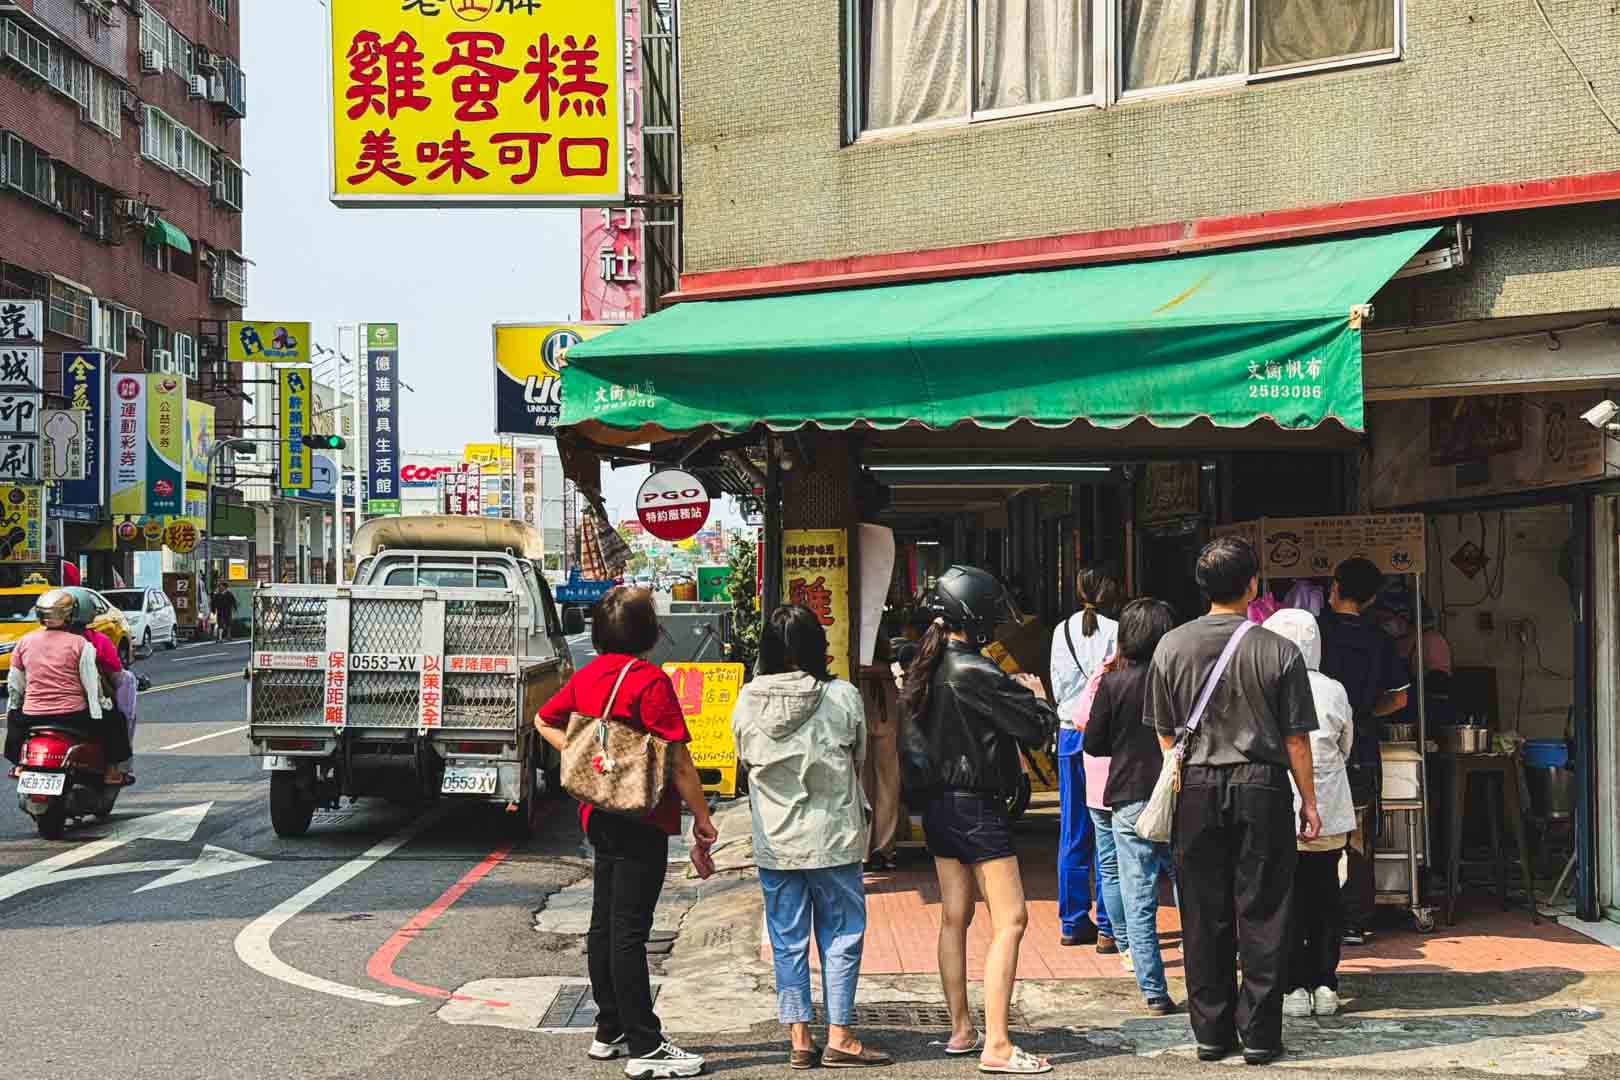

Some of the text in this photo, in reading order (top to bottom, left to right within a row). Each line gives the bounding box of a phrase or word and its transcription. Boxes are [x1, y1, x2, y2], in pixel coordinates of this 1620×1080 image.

[345, 30, 609, 122] 雞蛋糕
[346, 128, 610, 186] 美味可口
[527, 405, 558, 414] UNIQUE
[1249, 384, 1322, 399] 2583086
[120, 402, 137, 466] 運動彩券
[160, 400, 170, 448] 公益彩券
[375, 356, 392, 494] 億進寢具生活館
[643, 488, 700, 503] PGO
[645, 507, 702, 523] 特約服務站
[325, 652, 345, 724] 保持距離
[352, 655, 417, 670] 0553-XV
[420, 656, 441, 726] 以策安全
